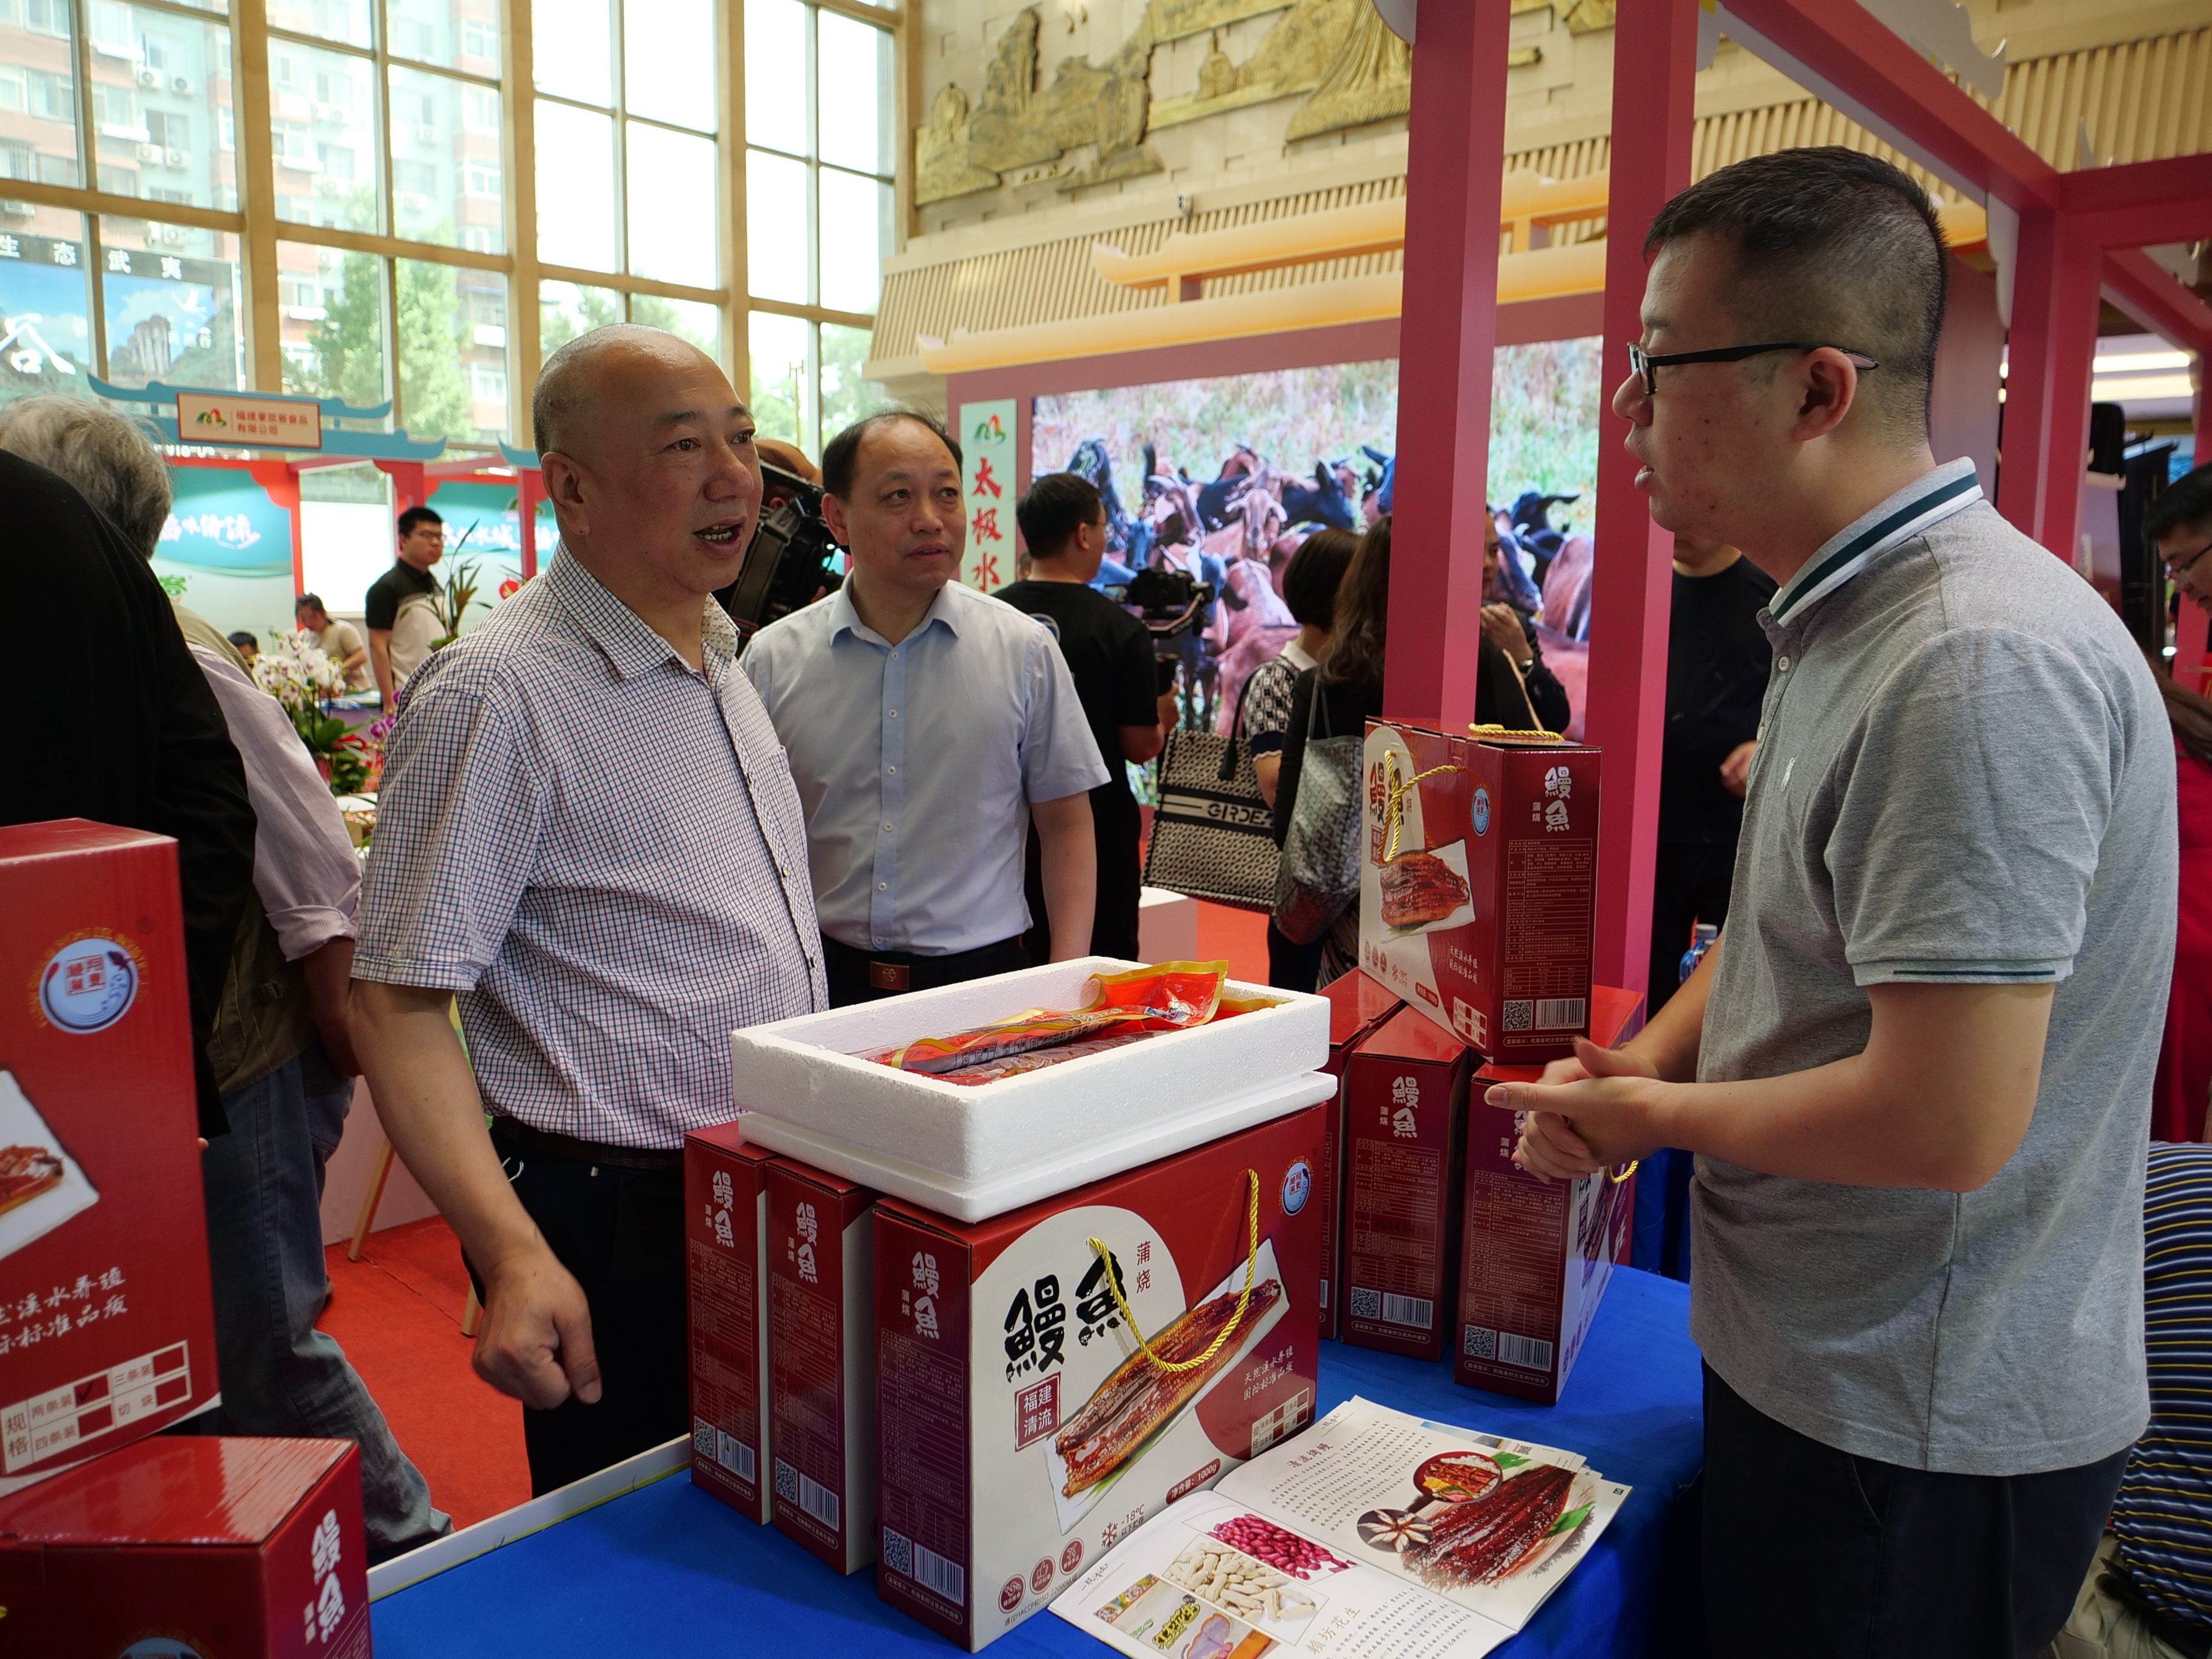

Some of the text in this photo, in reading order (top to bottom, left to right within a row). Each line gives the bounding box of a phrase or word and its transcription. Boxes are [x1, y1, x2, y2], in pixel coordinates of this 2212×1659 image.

[1532, 802, 1541, 822] 蒲烧
[1379, 1107, 1389, 1126] 蒲烧
[1500, 1137, 1509, 1158] 蒲烧
[705, 1204, 712, 1228] 蒲烧
[788, 1236, 795, 1262] 蒲烧
[1137, 1240, 1151, 1294] 蒲烧
[902, 1289, 910, 1316] 蒲烧
[31, 1393, 73, 1419] 两条装
[1023, 1384, 1053, 1414] 福建
[1023, 1411, 1053, 1438] 清流
[34, 1424, 78, 1452] 四条装
